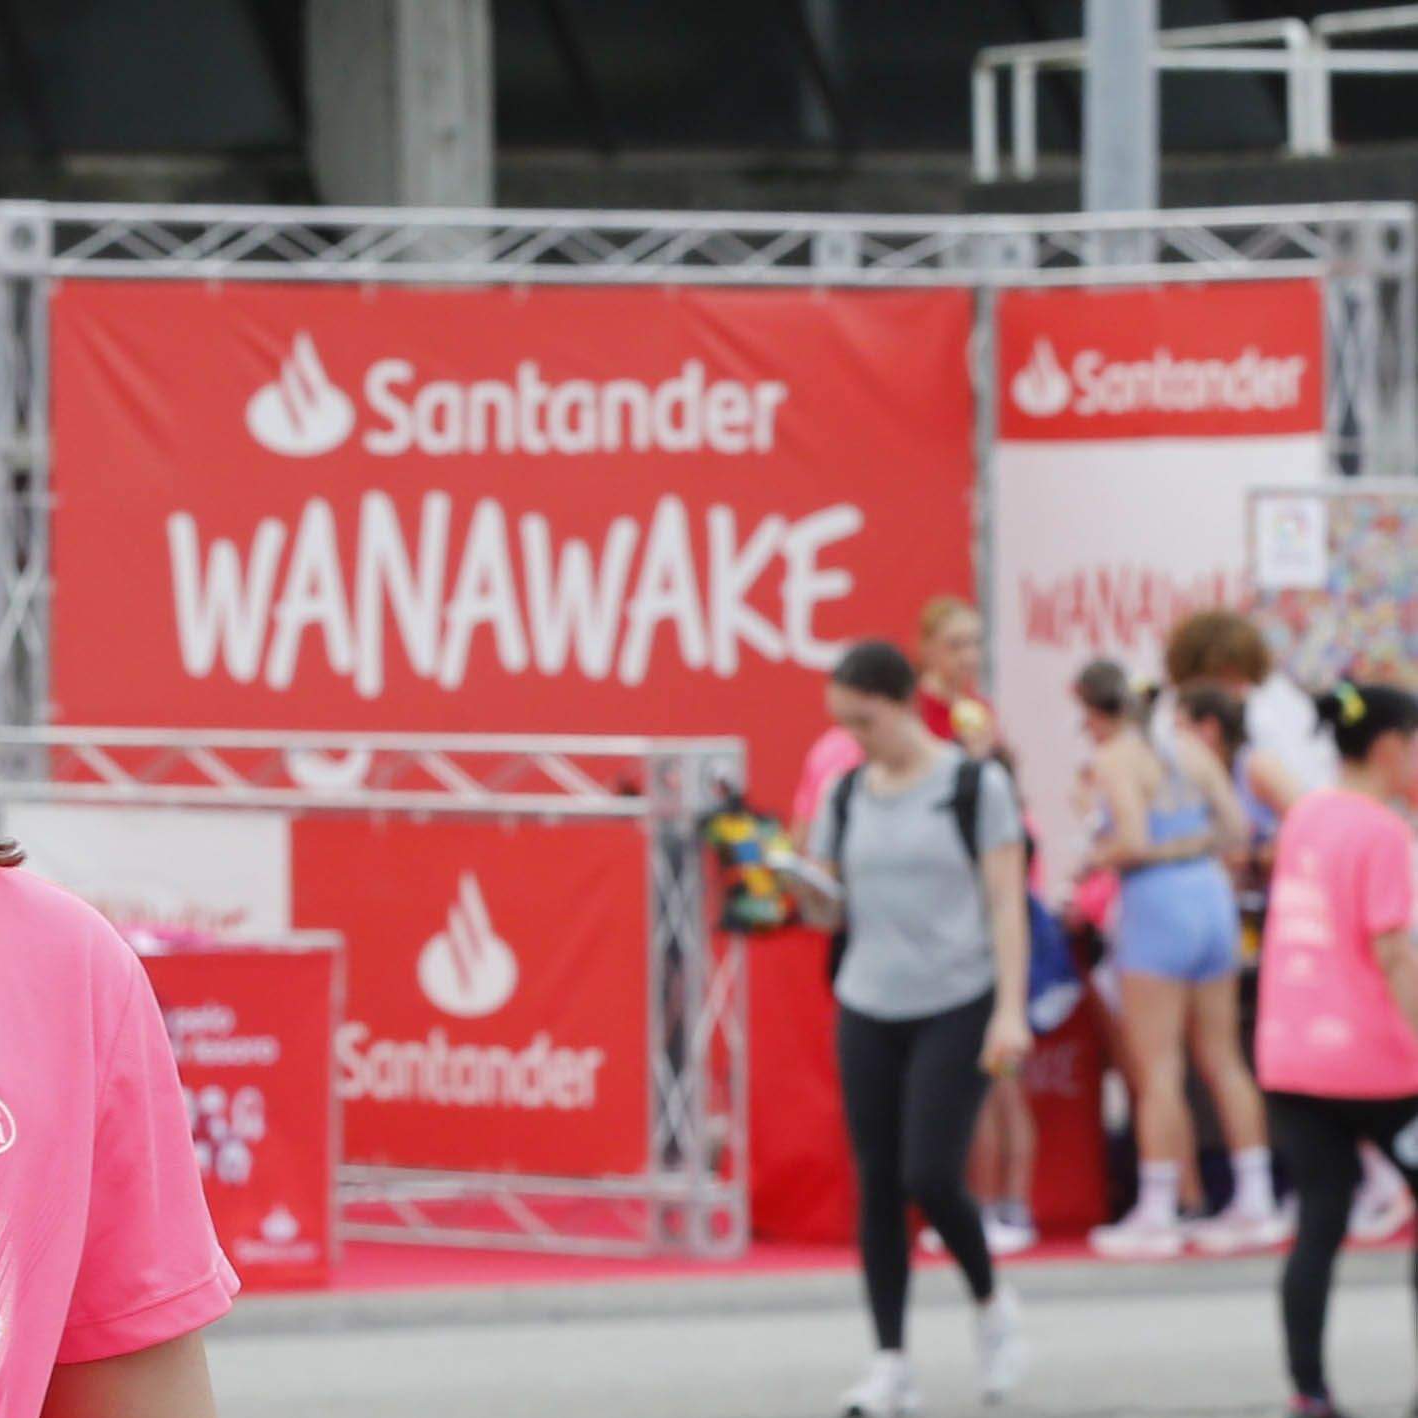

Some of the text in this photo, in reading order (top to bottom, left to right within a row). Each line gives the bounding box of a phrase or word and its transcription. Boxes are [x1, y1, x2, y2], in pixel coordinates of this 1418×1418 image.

[364, 359, 789, 456] Santander
[1072, 343, 1309, 416] Santander
[168, 489, 864, 699] WANAWAKE
[334, 1022, 605, 1110] Santander
